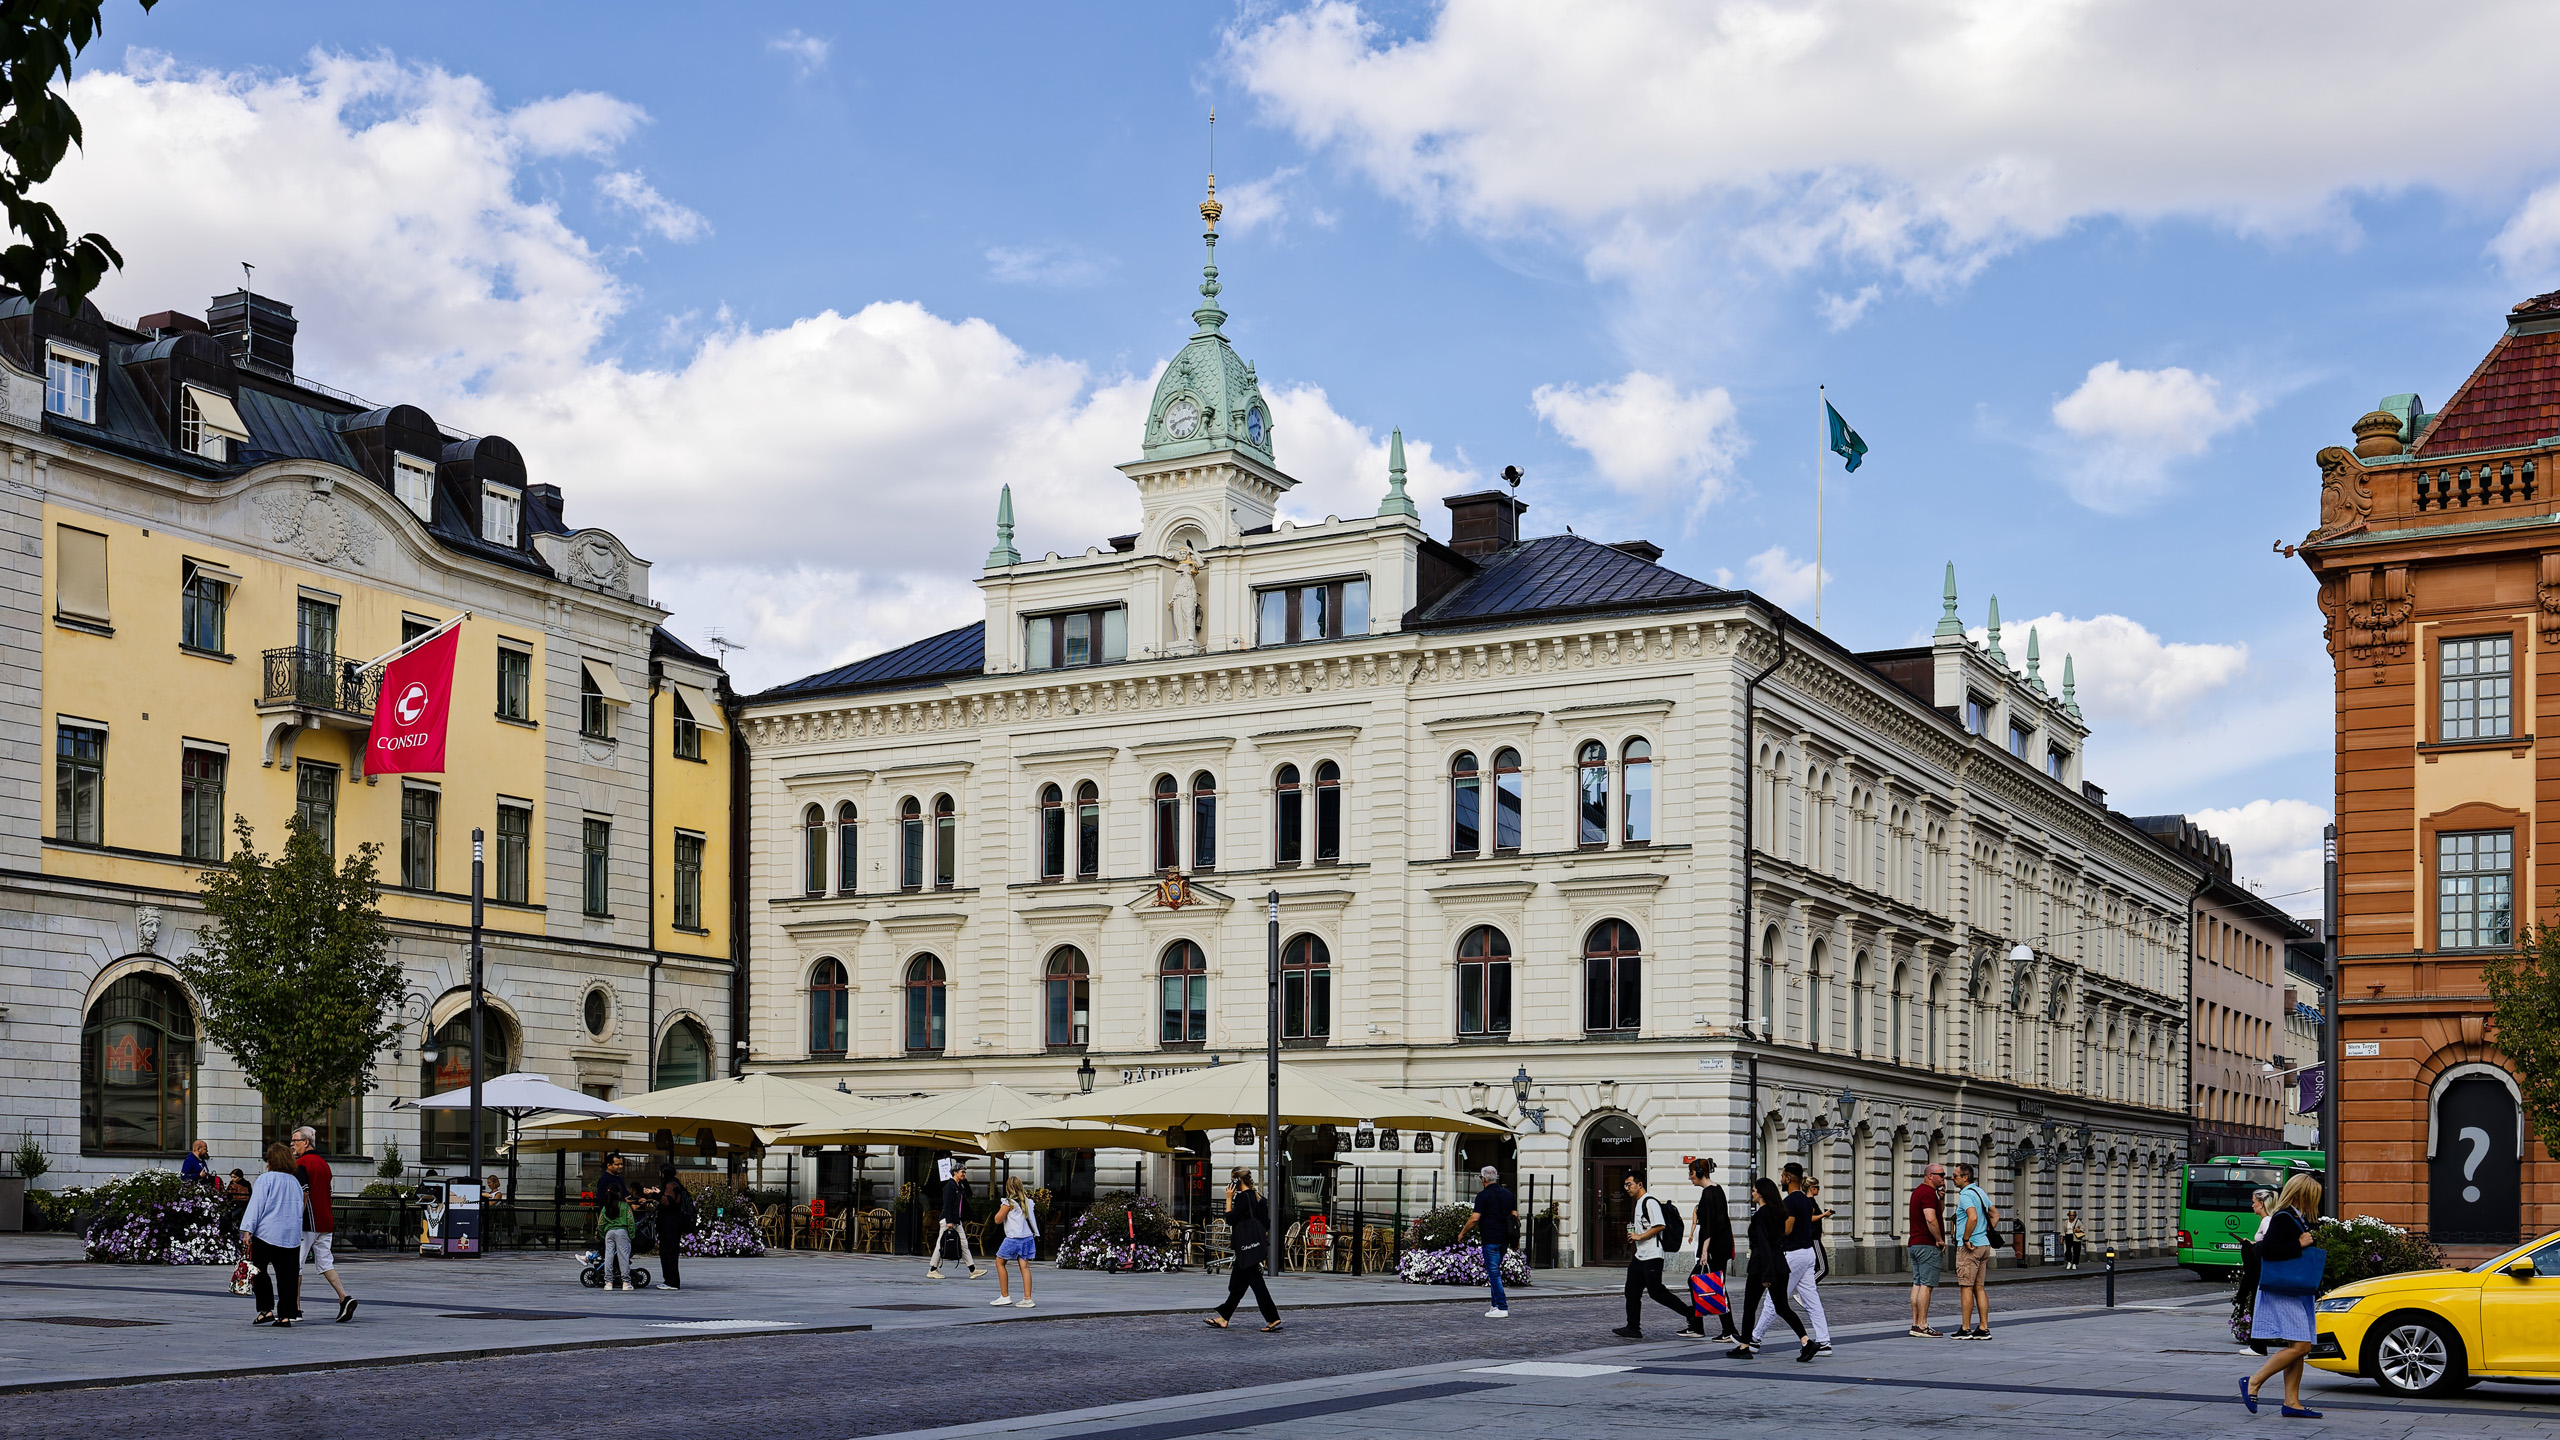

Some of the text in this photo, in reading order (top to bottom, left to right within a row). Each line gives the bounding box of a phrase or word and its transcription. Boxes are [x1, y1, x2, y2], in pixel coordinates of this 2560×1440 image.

[377, 733, 428, 751] CONSID
[106, 1033, 153, 1072] MAX
[1601, 1134, 1632, 1146] norrgavel
[2234, 1171, 2241, 1180] 7
[2227, 1218, 2239, 1227] UL
